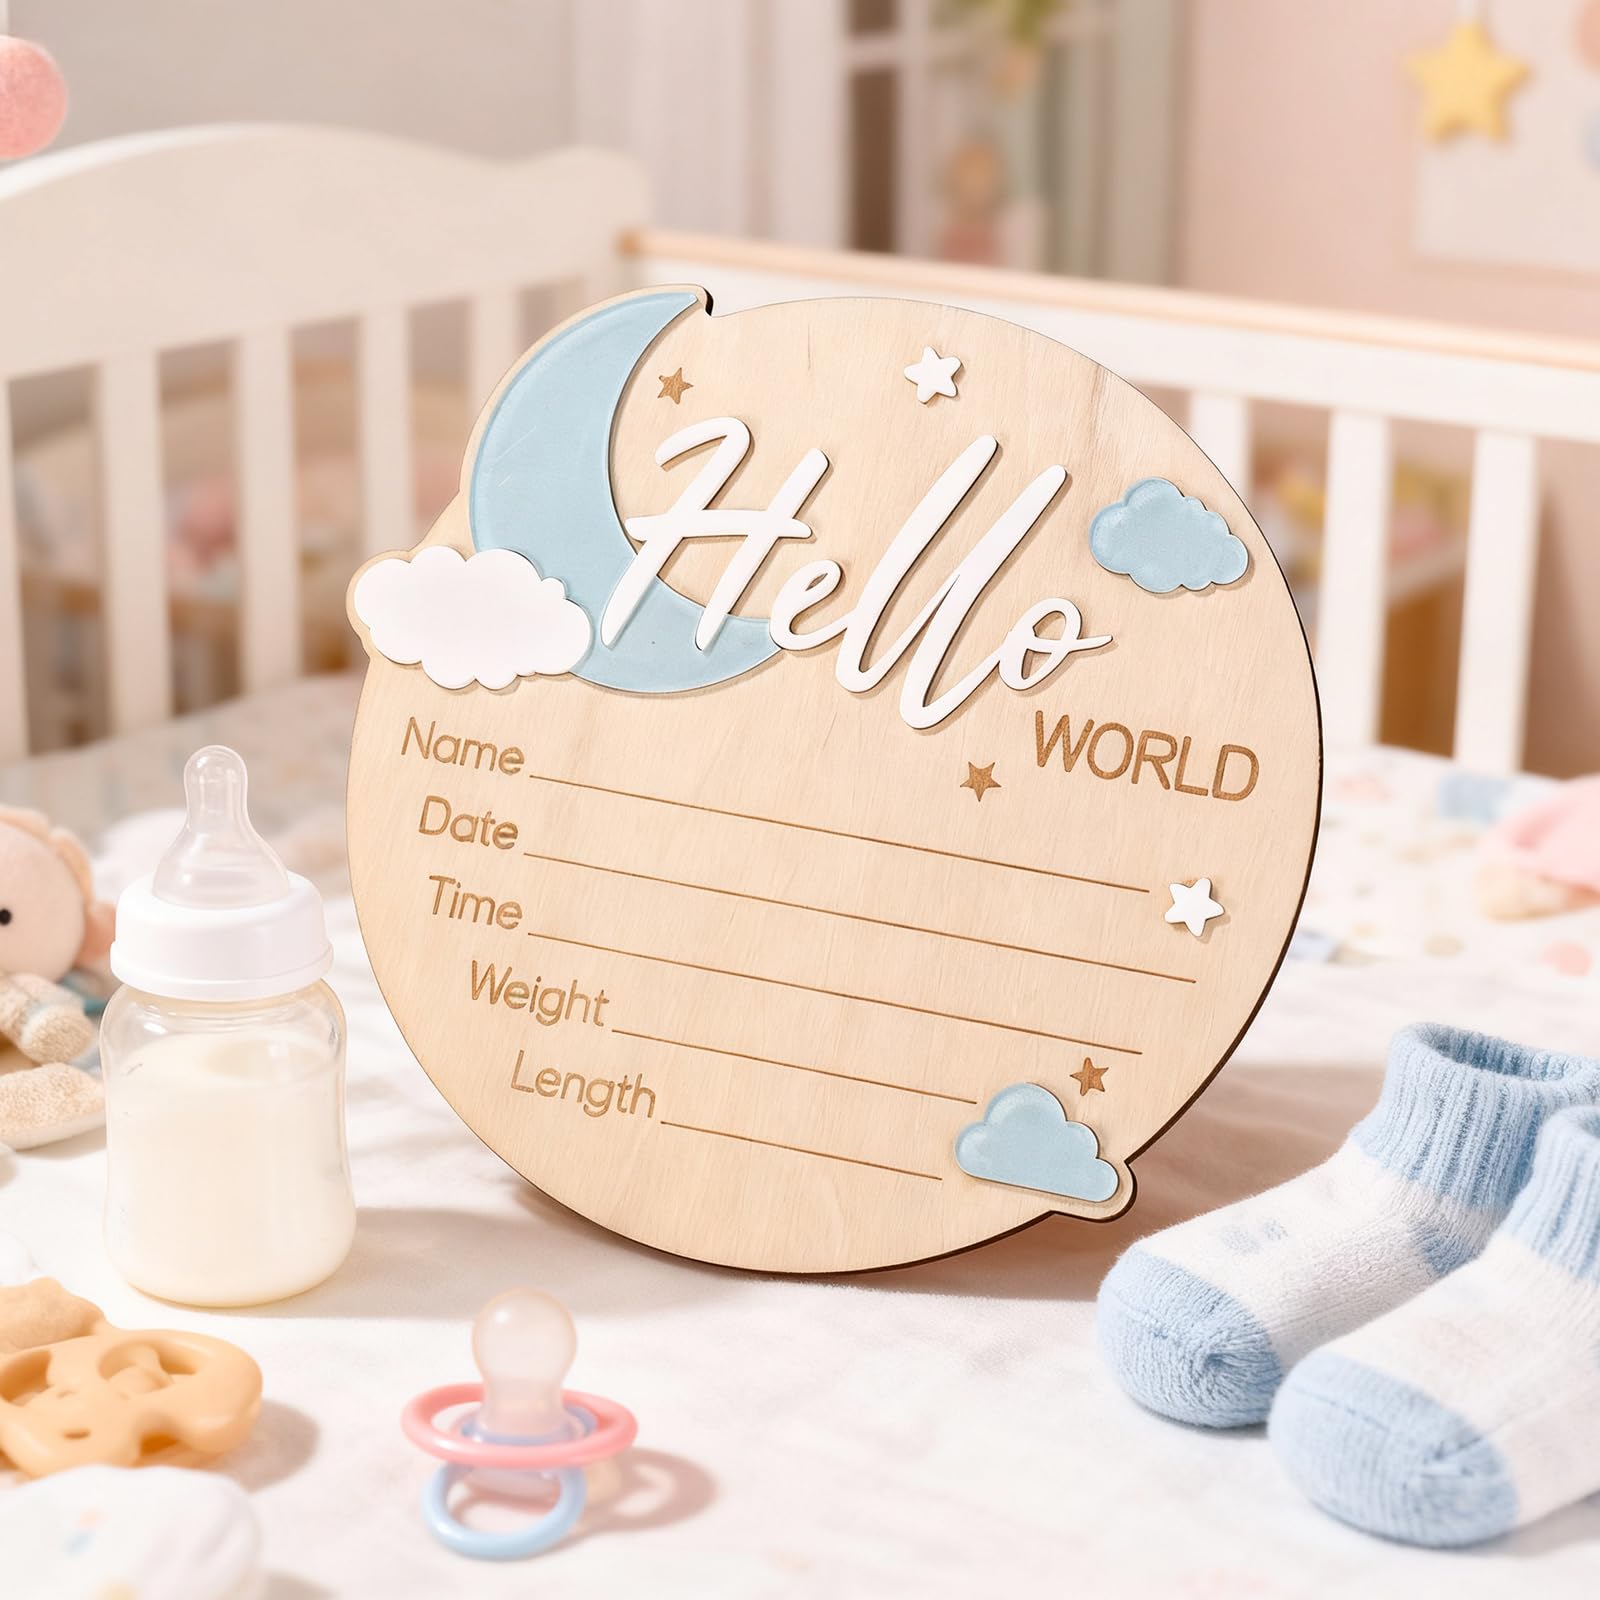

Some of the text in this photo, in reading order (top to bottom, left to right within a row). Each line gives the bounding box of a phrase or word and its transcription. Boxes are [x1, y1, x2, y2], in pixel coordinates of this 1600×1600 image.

[601, 416, 1113, 730] Hello
[401, 716, 525, 776] Name
[1034, 710, 1260, 802] WORLD
[418, 795, 519, 850] Date
[428, 874, 523, 930] Time
[470, 960, 610, 1027] Weight
[510, 1049, 656, 1118] Length
